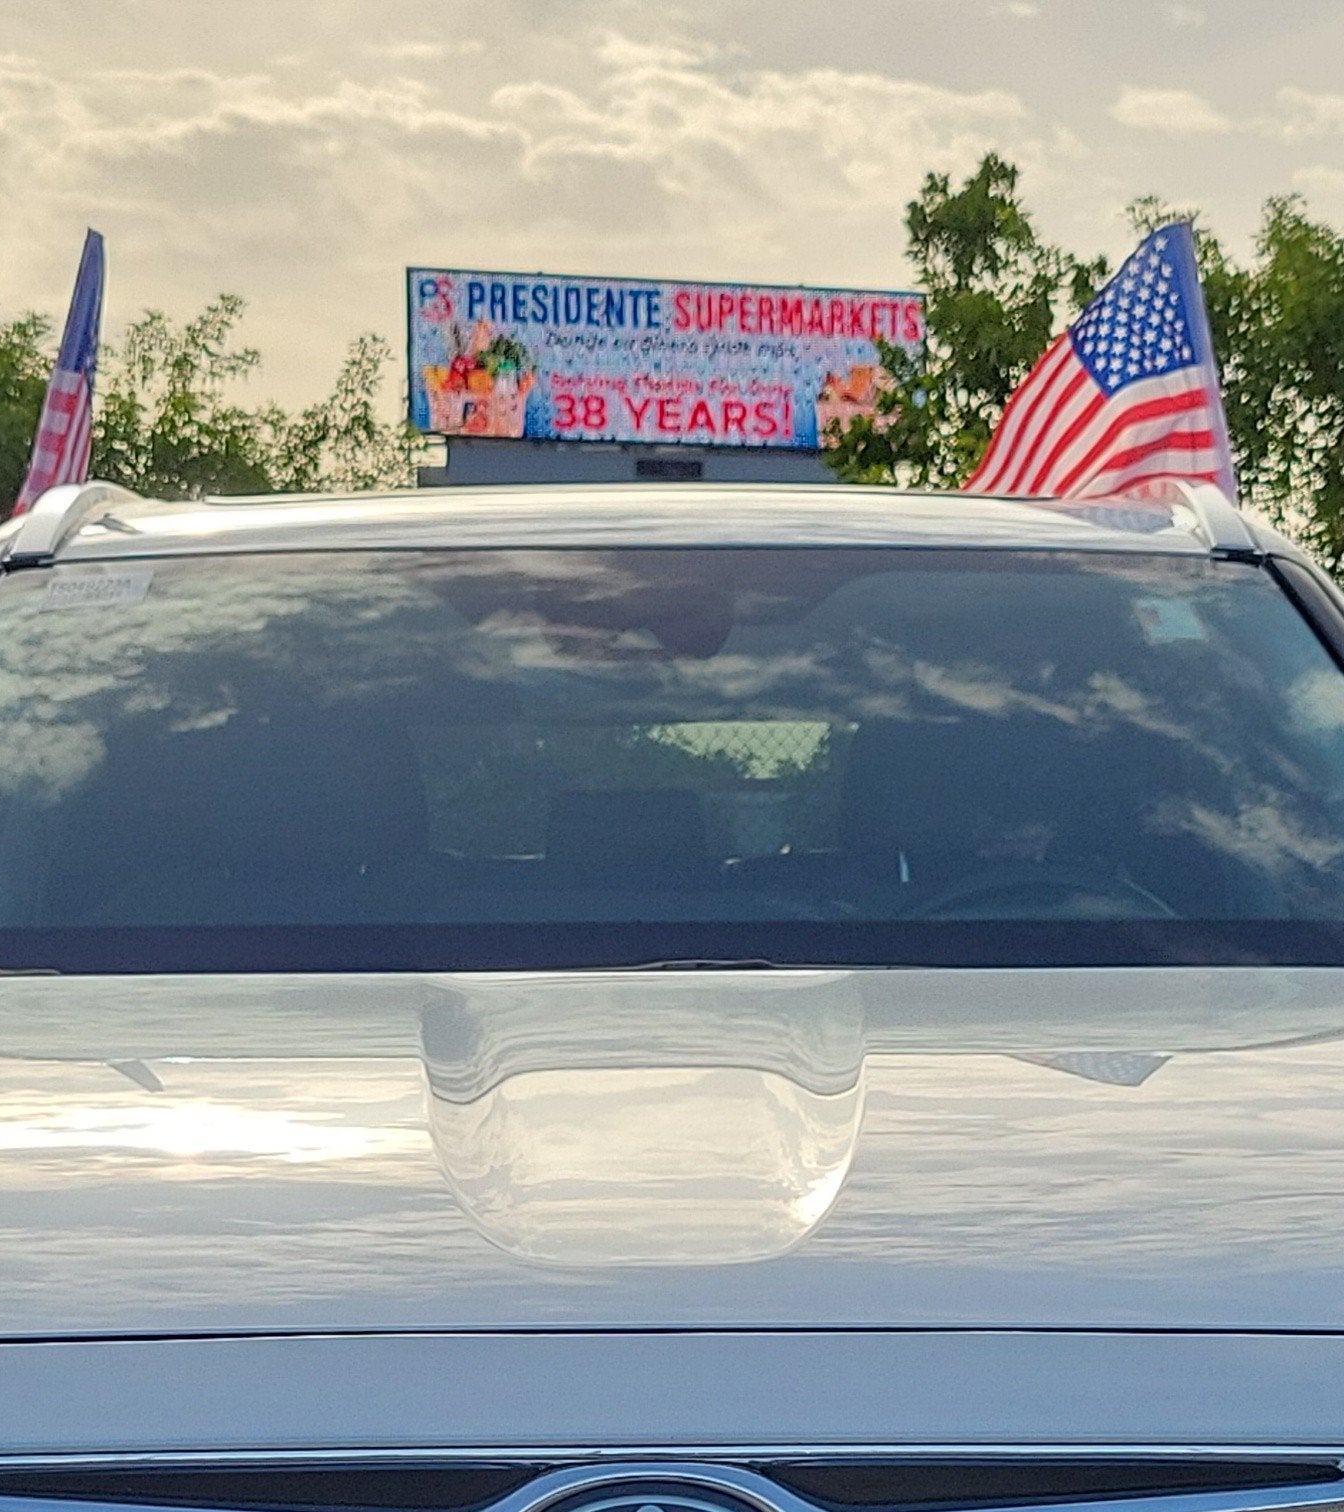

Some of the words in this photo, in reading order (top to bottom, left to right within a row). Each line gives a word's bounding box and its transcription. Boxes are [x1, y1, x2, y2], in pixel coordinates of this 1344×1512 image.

[467, 281, 662, 330] PRESIDENTE
[673, 291, 921, 342] SUPERMARKETS
[553, 393, 608, 431] 38
[622, 394, 793, 438] YEARS!
